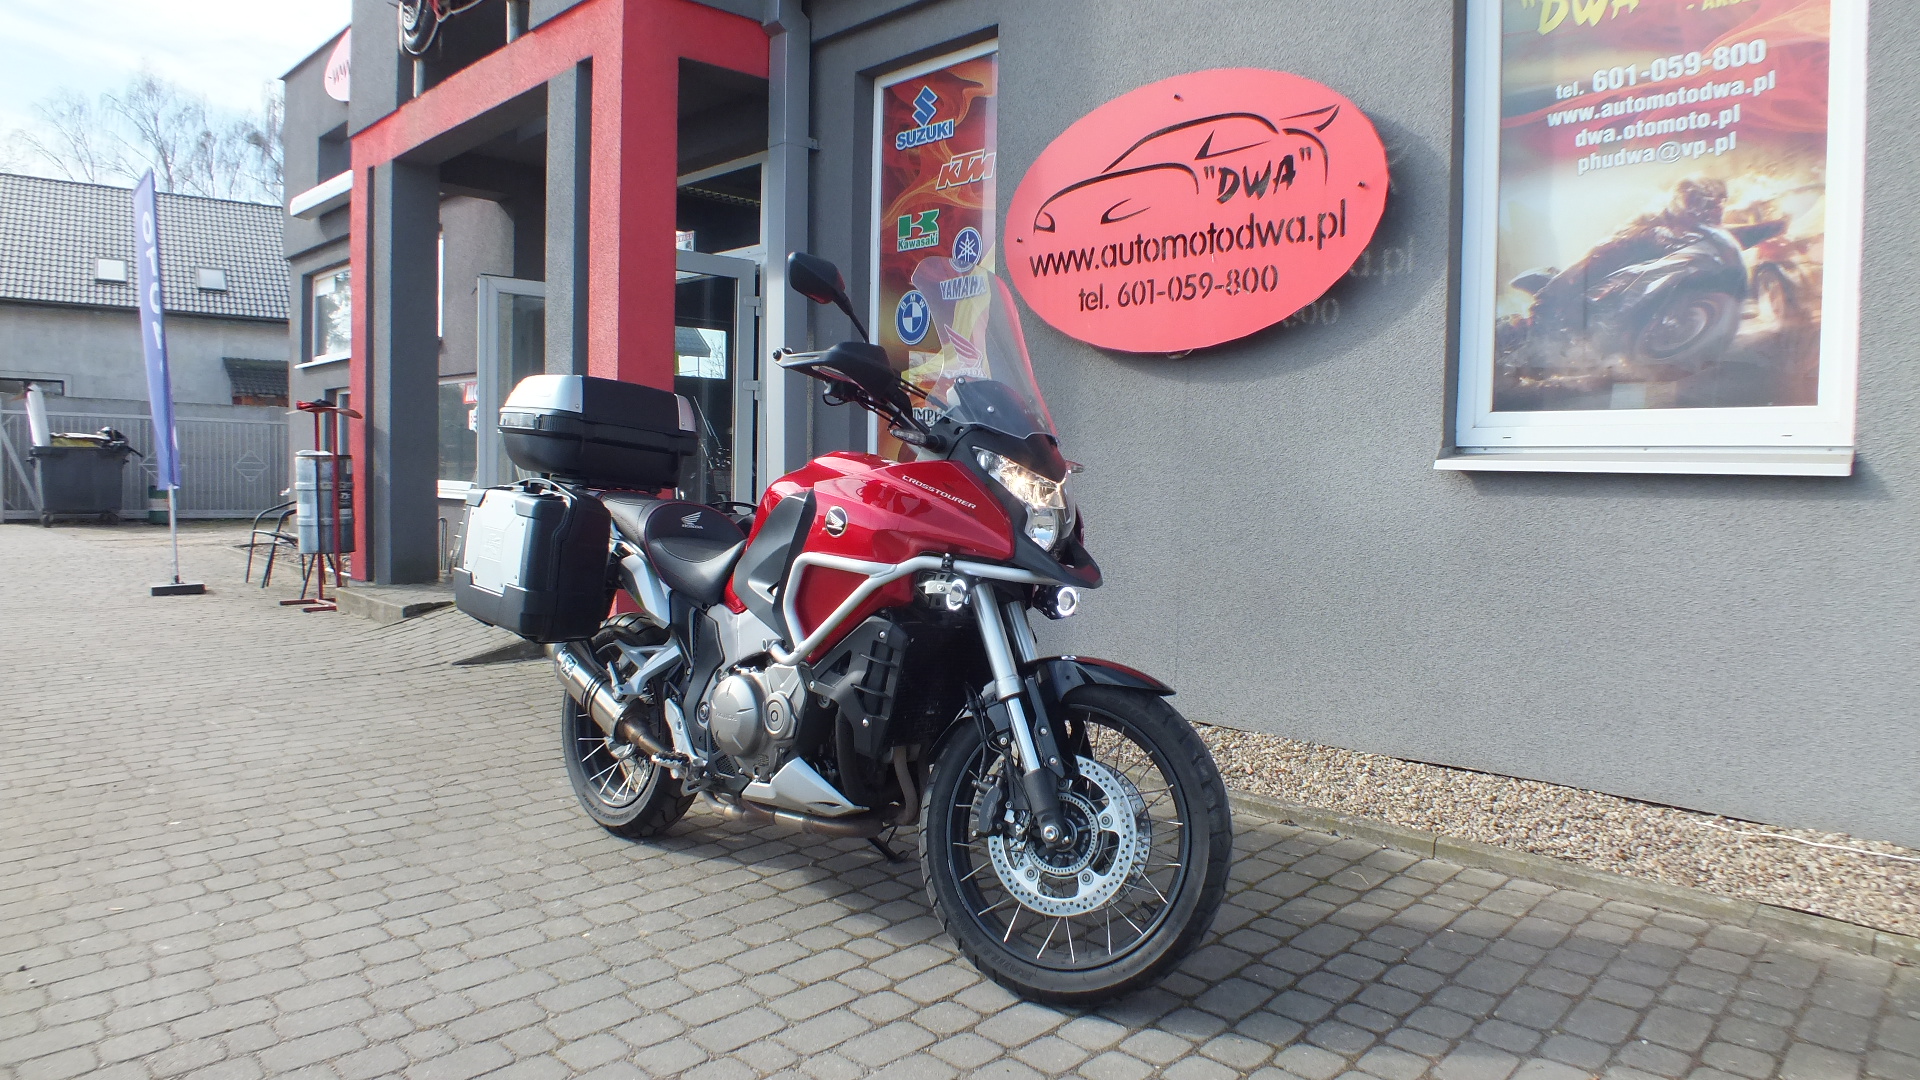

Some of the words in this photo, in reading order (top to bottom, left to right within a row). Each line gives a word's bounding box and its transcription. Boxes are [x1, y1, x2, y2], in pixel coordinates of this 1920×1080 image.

[1555, 81, 1585, 100] tel.
[1592, 38, 1767, 93] 601-059-800
[1547, 70, 1776, 127] www.automotodwa.pl
[896, 118, 956, 150] SUZUKI
[1575, 104, 1741, 147] dwa.otomoto.pl
[936, 149, 997, 190] KTM
[1577, 131, 1737, 175] phudwa@vp.pl
[1203, 146, 1312, 204] "DWA"
[898, 233, 938, 250] Kawasaki
[1029, 198, 1346, 278] www.automotodwa.pl
[940, 275, 987, 299] YAMAHA
[1079, 284, 1110, 312] tel.
[1117, 264, 1279, 306] 601-059-800
[901, 474, 977, 510] CROSSTOURER
